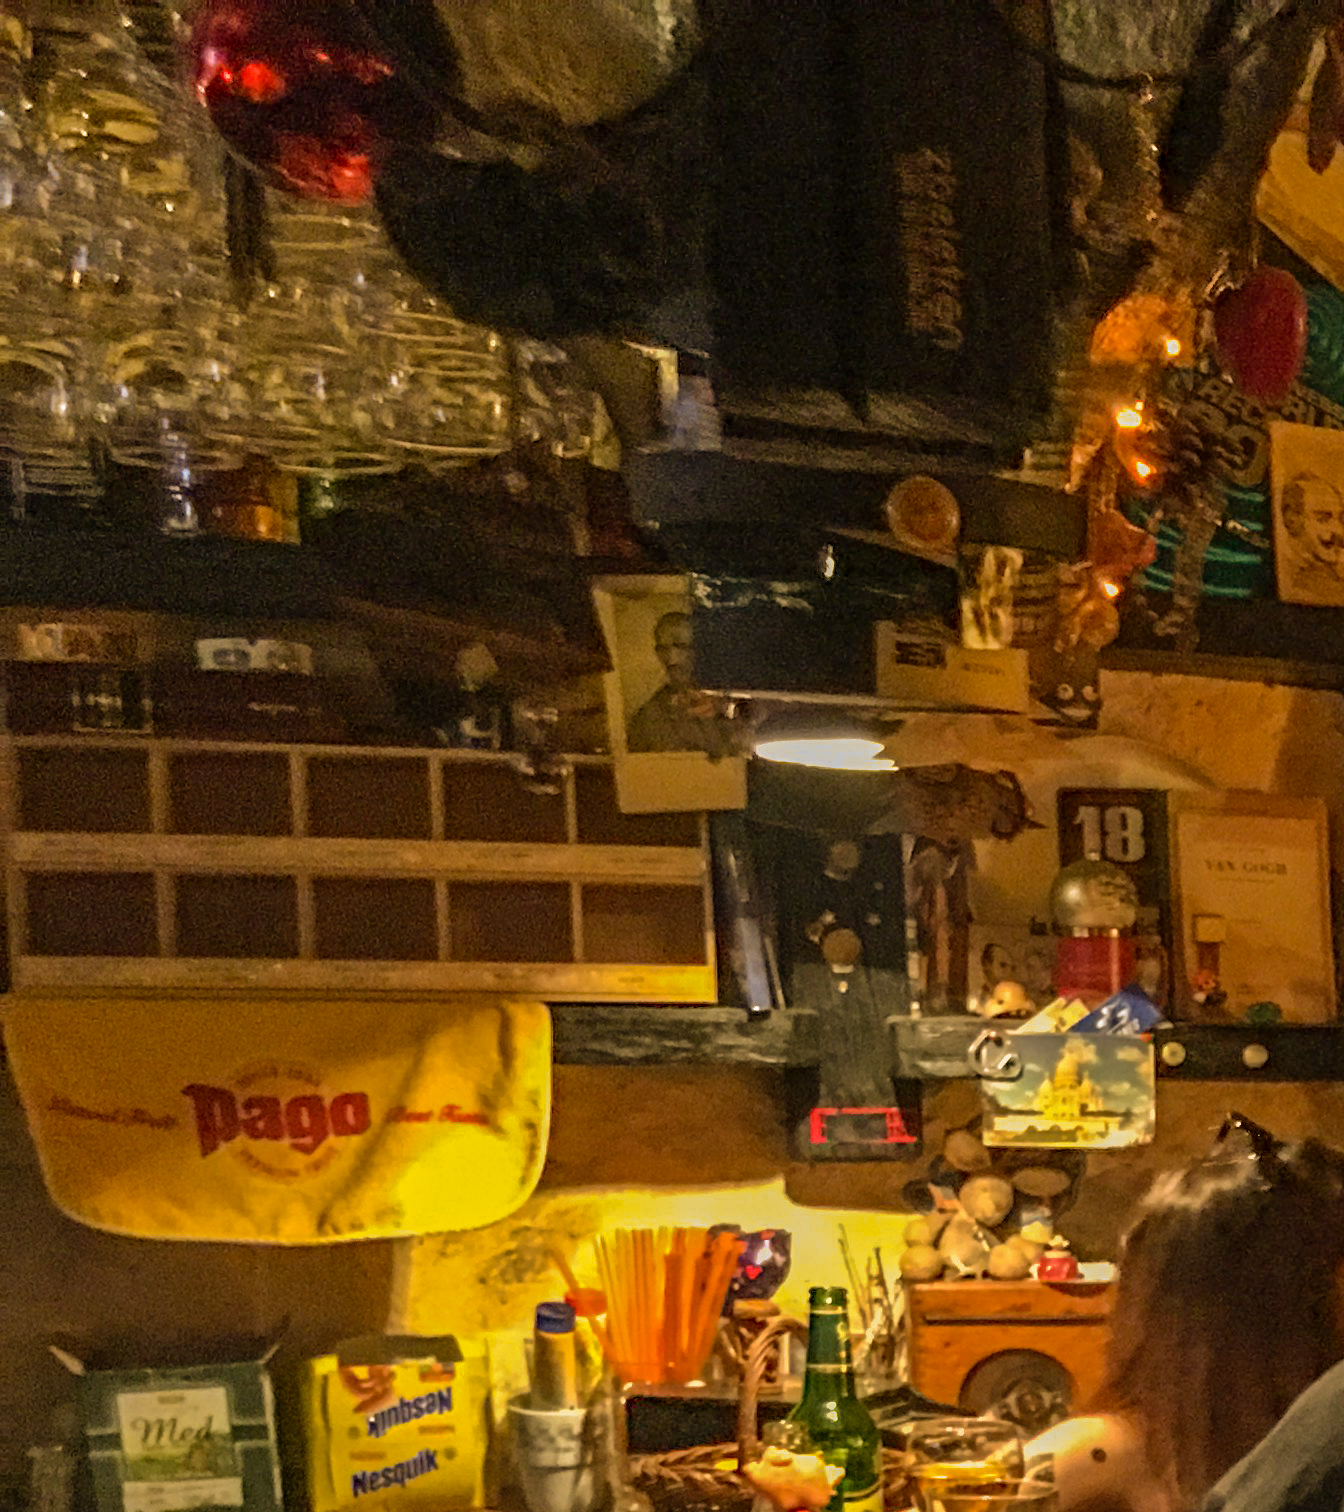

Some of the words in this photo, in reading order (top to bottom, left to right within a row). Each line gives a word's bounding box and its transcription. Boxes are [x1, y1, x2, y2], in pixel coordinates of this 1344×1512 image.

[1074, 804, 1147, 863] 18
[130, 1415, 214, 1446] Med
[367, 1387, 453, 1438] Nesquik
[352, 1448, 439, 1499] Nesquik
